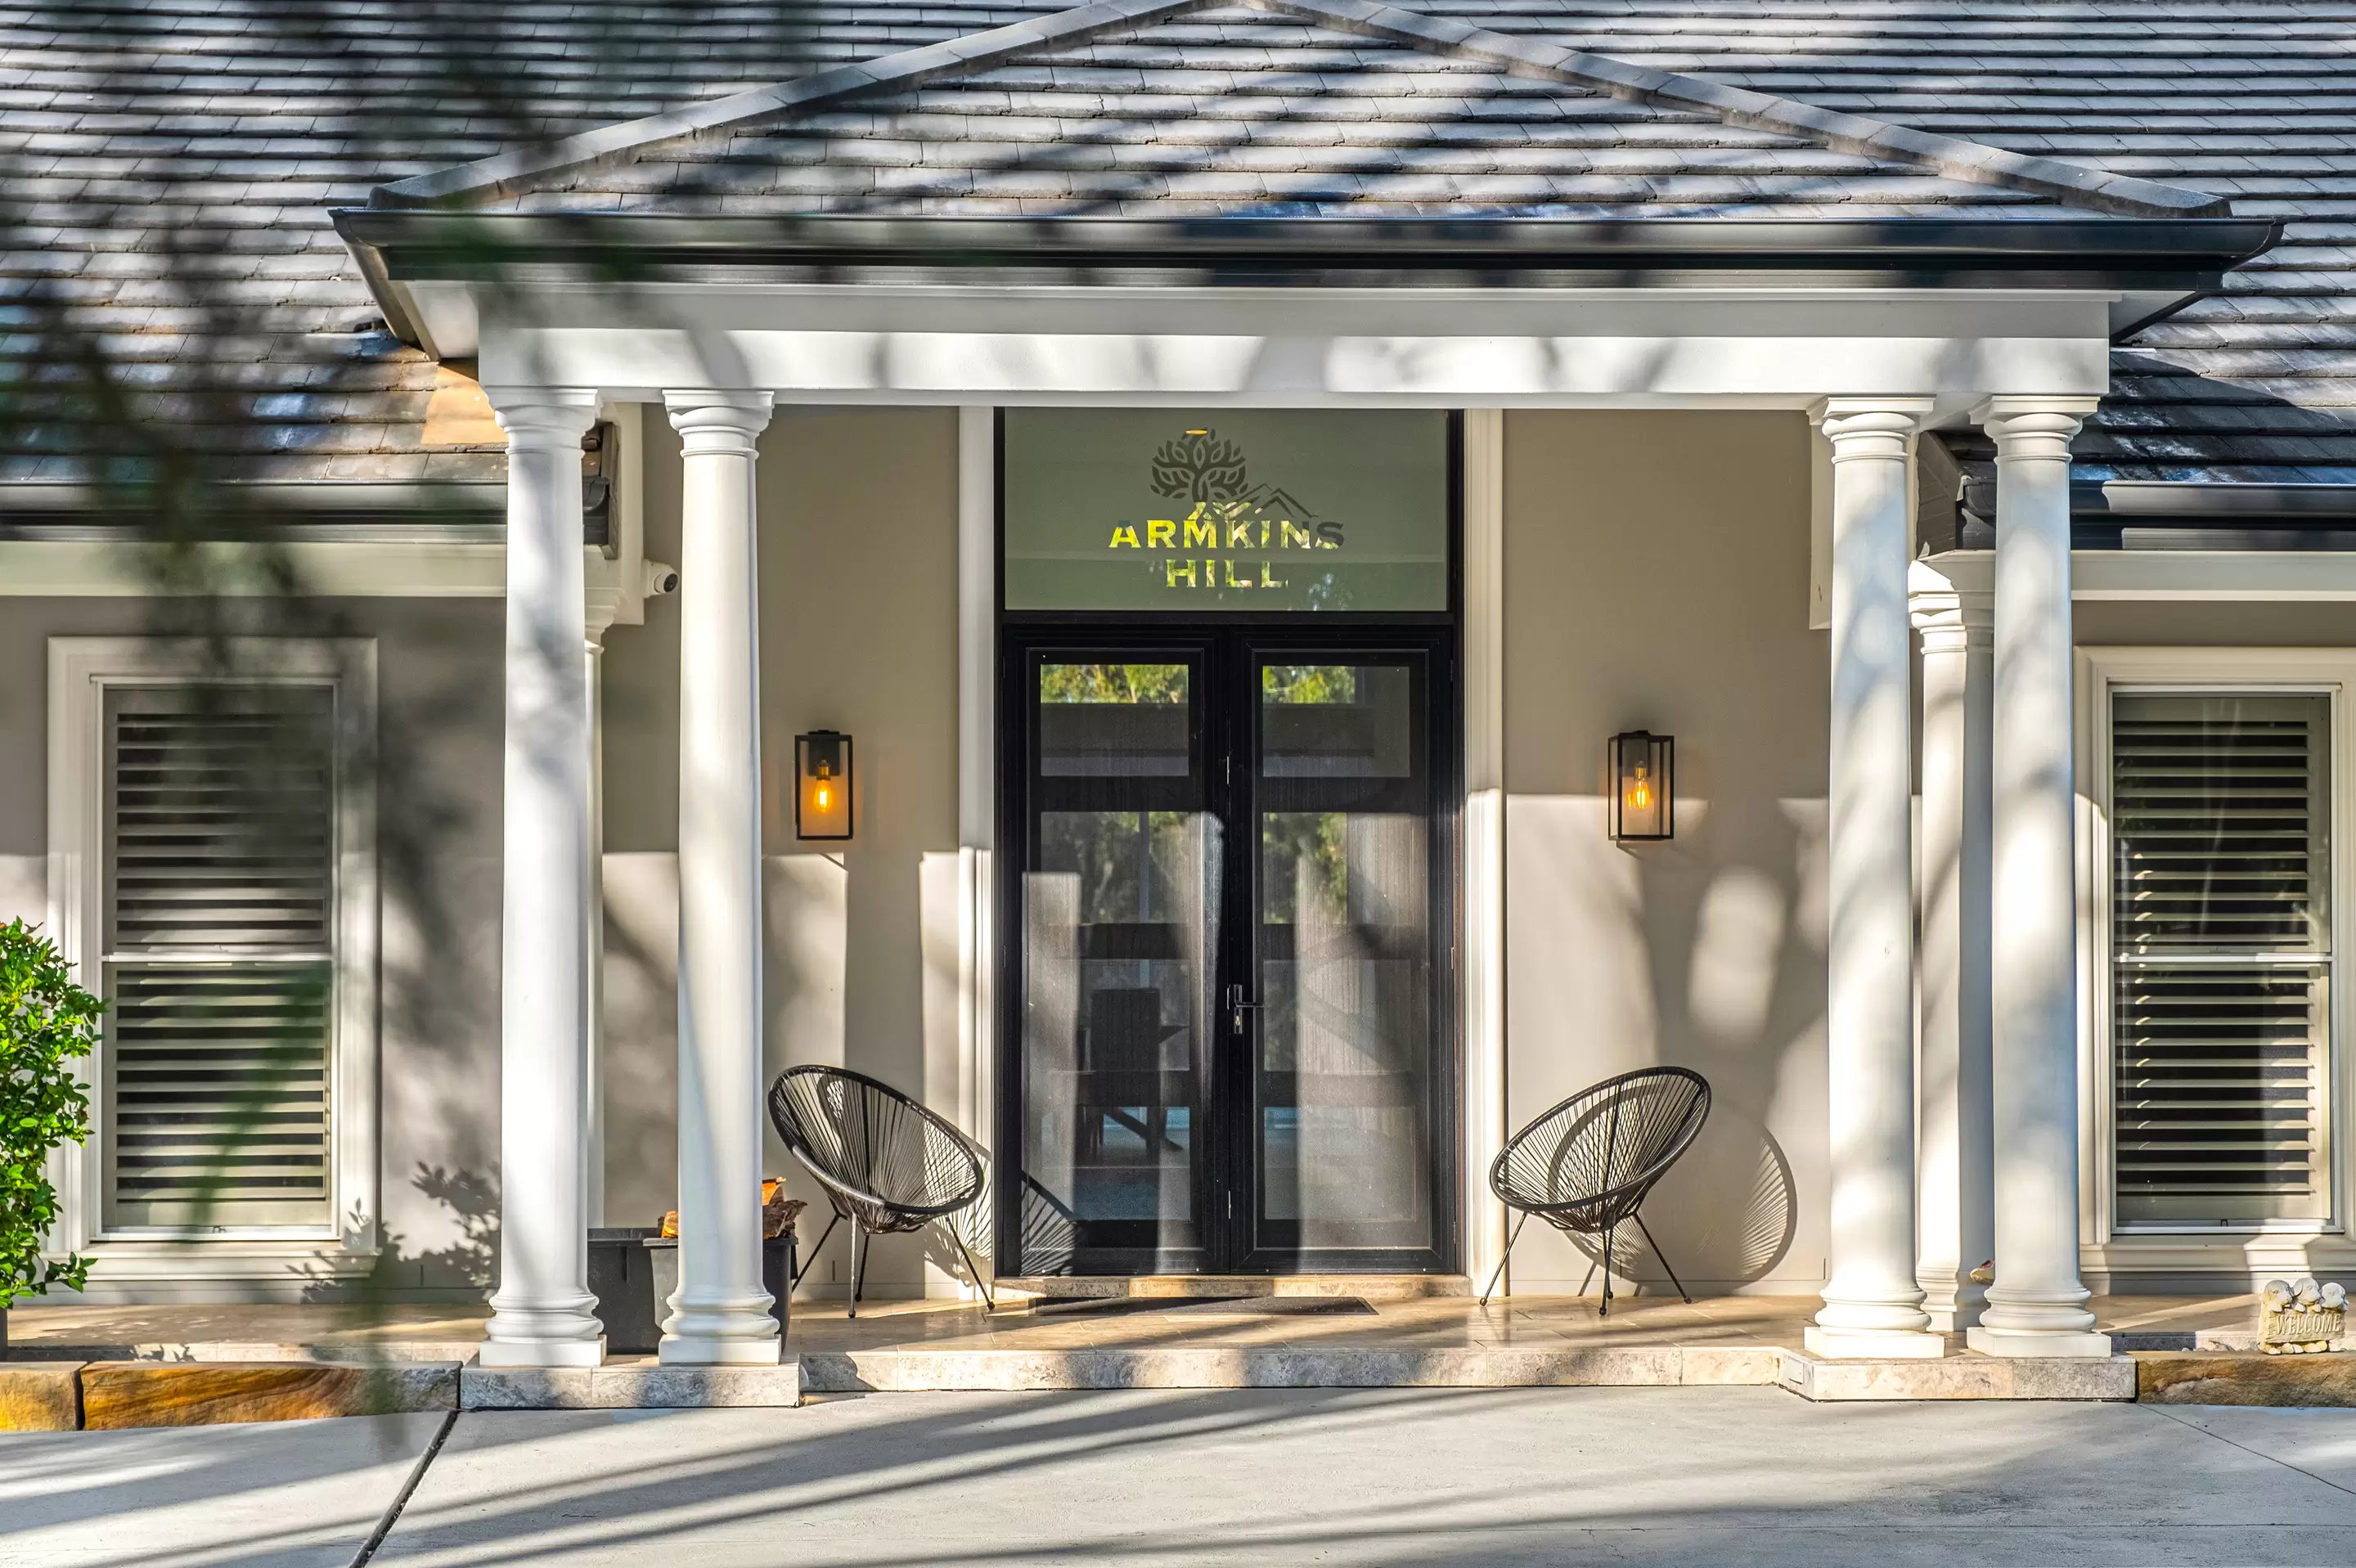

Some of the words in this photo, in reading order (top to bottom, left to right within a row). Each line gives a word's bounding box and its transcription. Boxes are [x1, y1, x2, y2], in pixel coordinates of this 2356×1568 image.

[1108, 519, 1345, 549] ARMKINS
[1166, 559, 1288, 588] HILL
[2277, 1313, 2340, 1335] WELCOME
